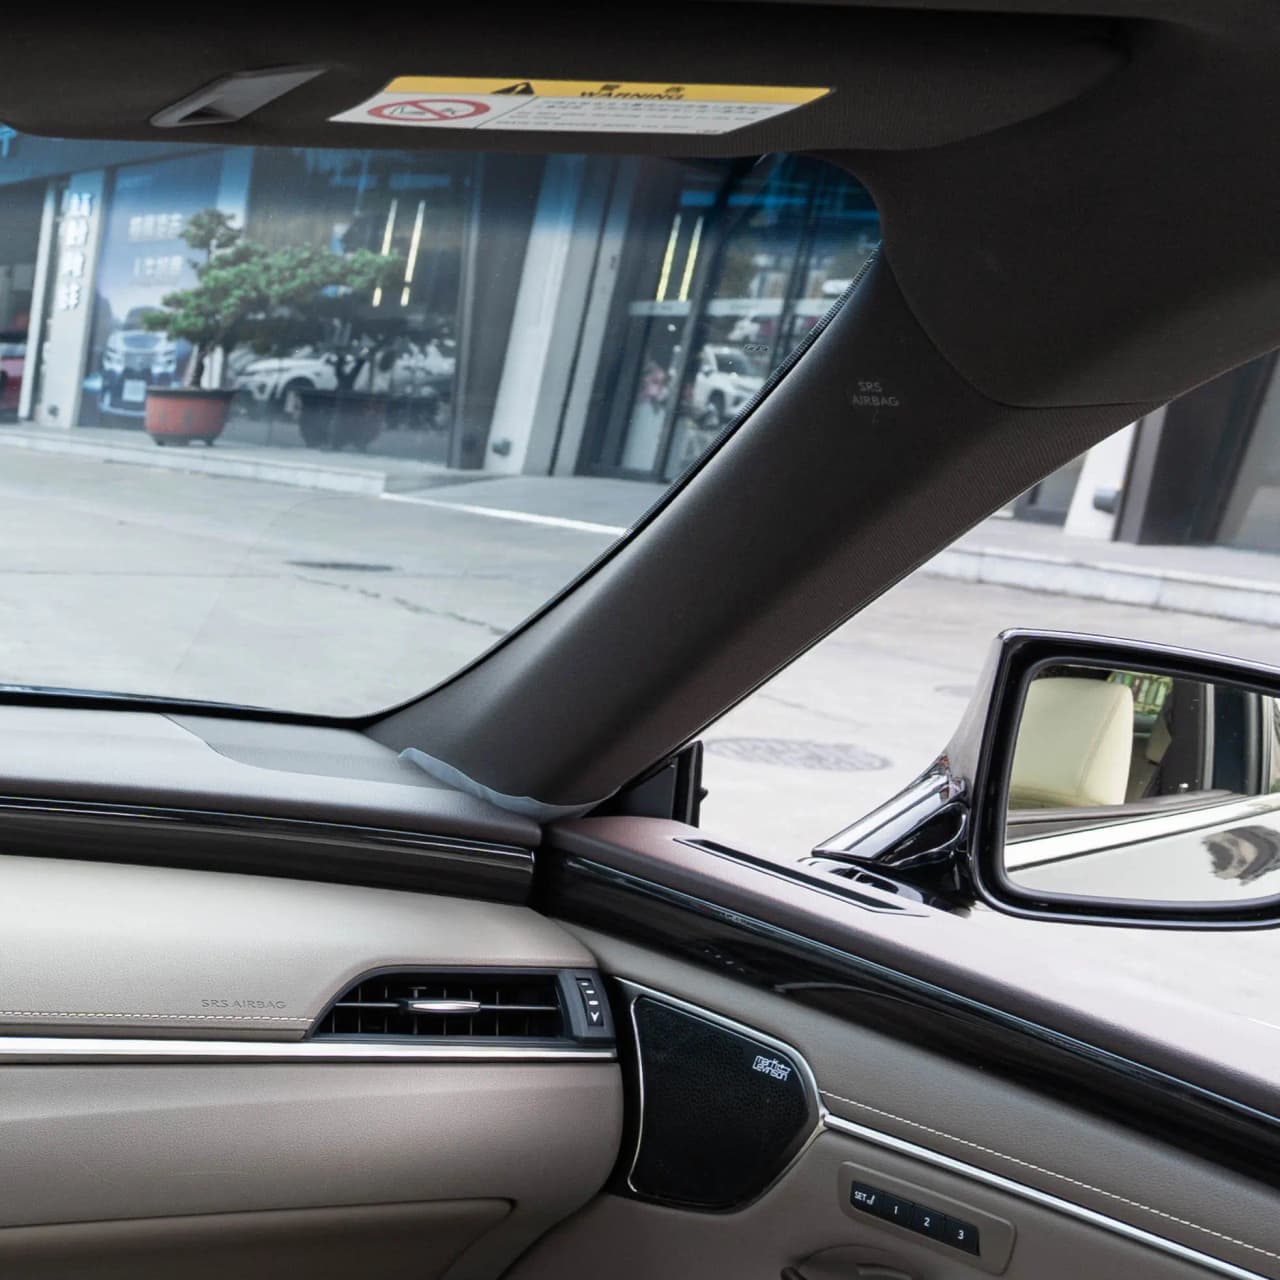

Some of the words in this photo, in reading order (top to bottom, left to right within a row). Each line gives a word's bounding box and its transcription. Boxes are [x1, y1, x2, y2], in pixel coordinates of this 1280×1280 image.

[201, 999, 230, 1008] SRS
[231, 999, 288, 1010] AIRBAG
[854, 1191, 868, 1202] SET
[923, 1217, 931, 1227] 2
[957, 1229, 965, 1240] 3
